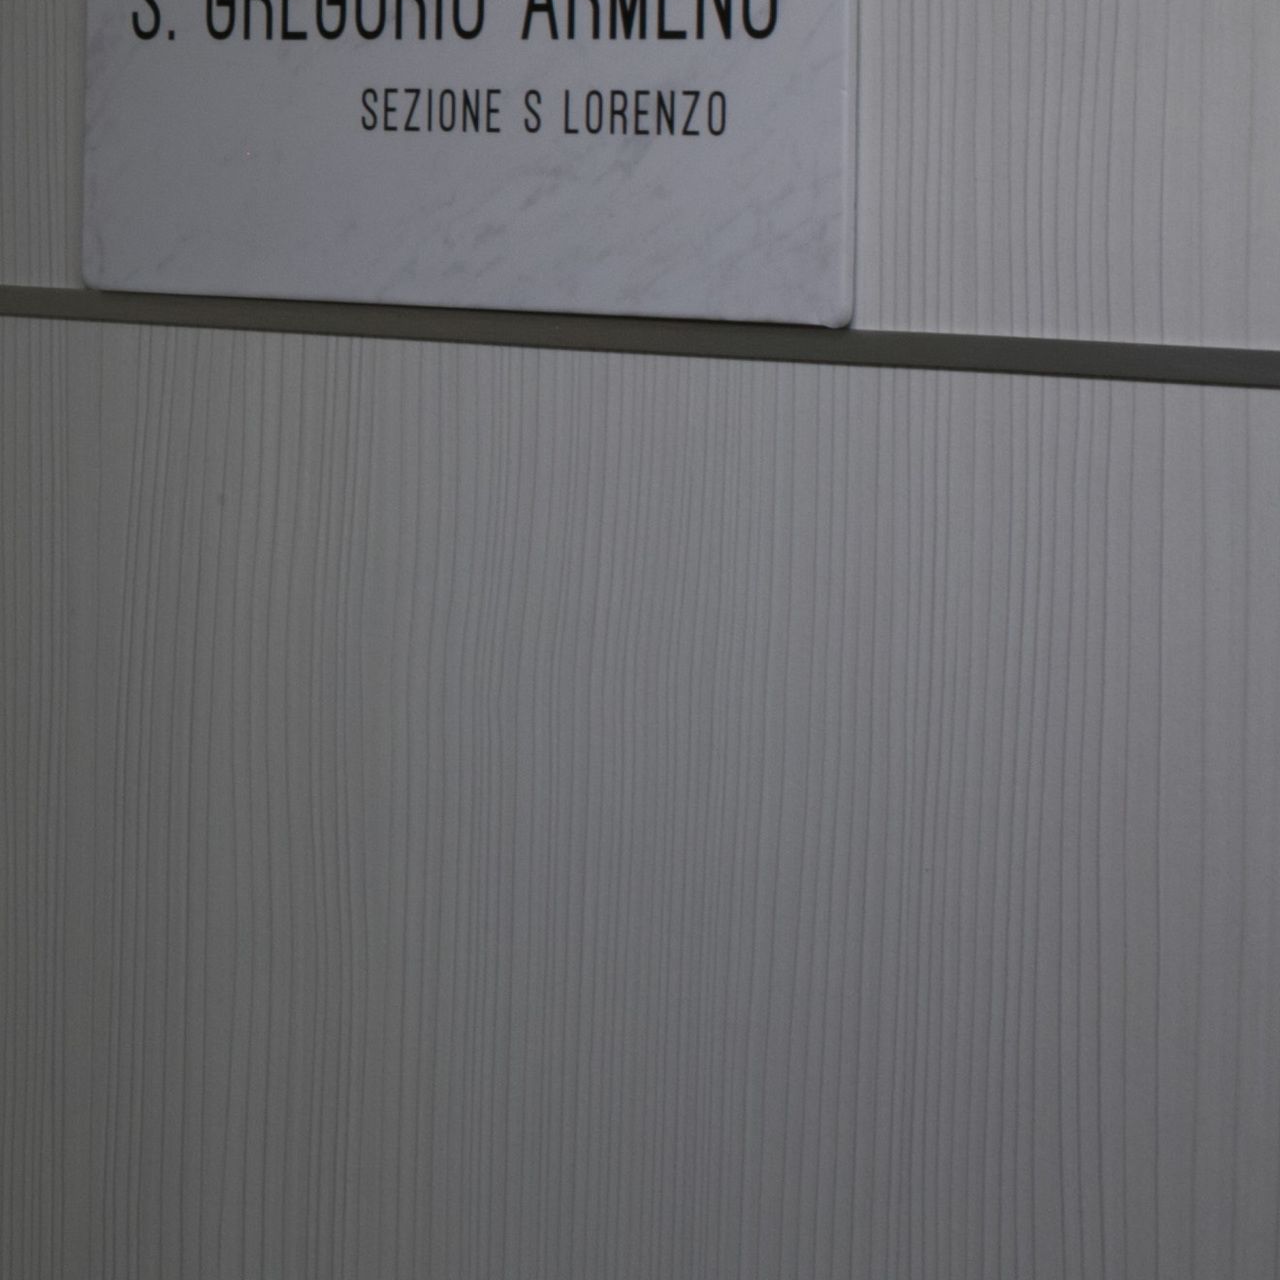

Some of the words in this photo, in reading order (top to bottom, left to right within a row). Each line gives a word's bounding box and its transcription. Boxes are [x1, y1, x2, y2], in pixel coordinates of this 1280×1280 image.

[360, 86, 502, 134] SEZIONE
[523, 88, 543, 134] S
[562, 88, 728, 137] LORENZO
